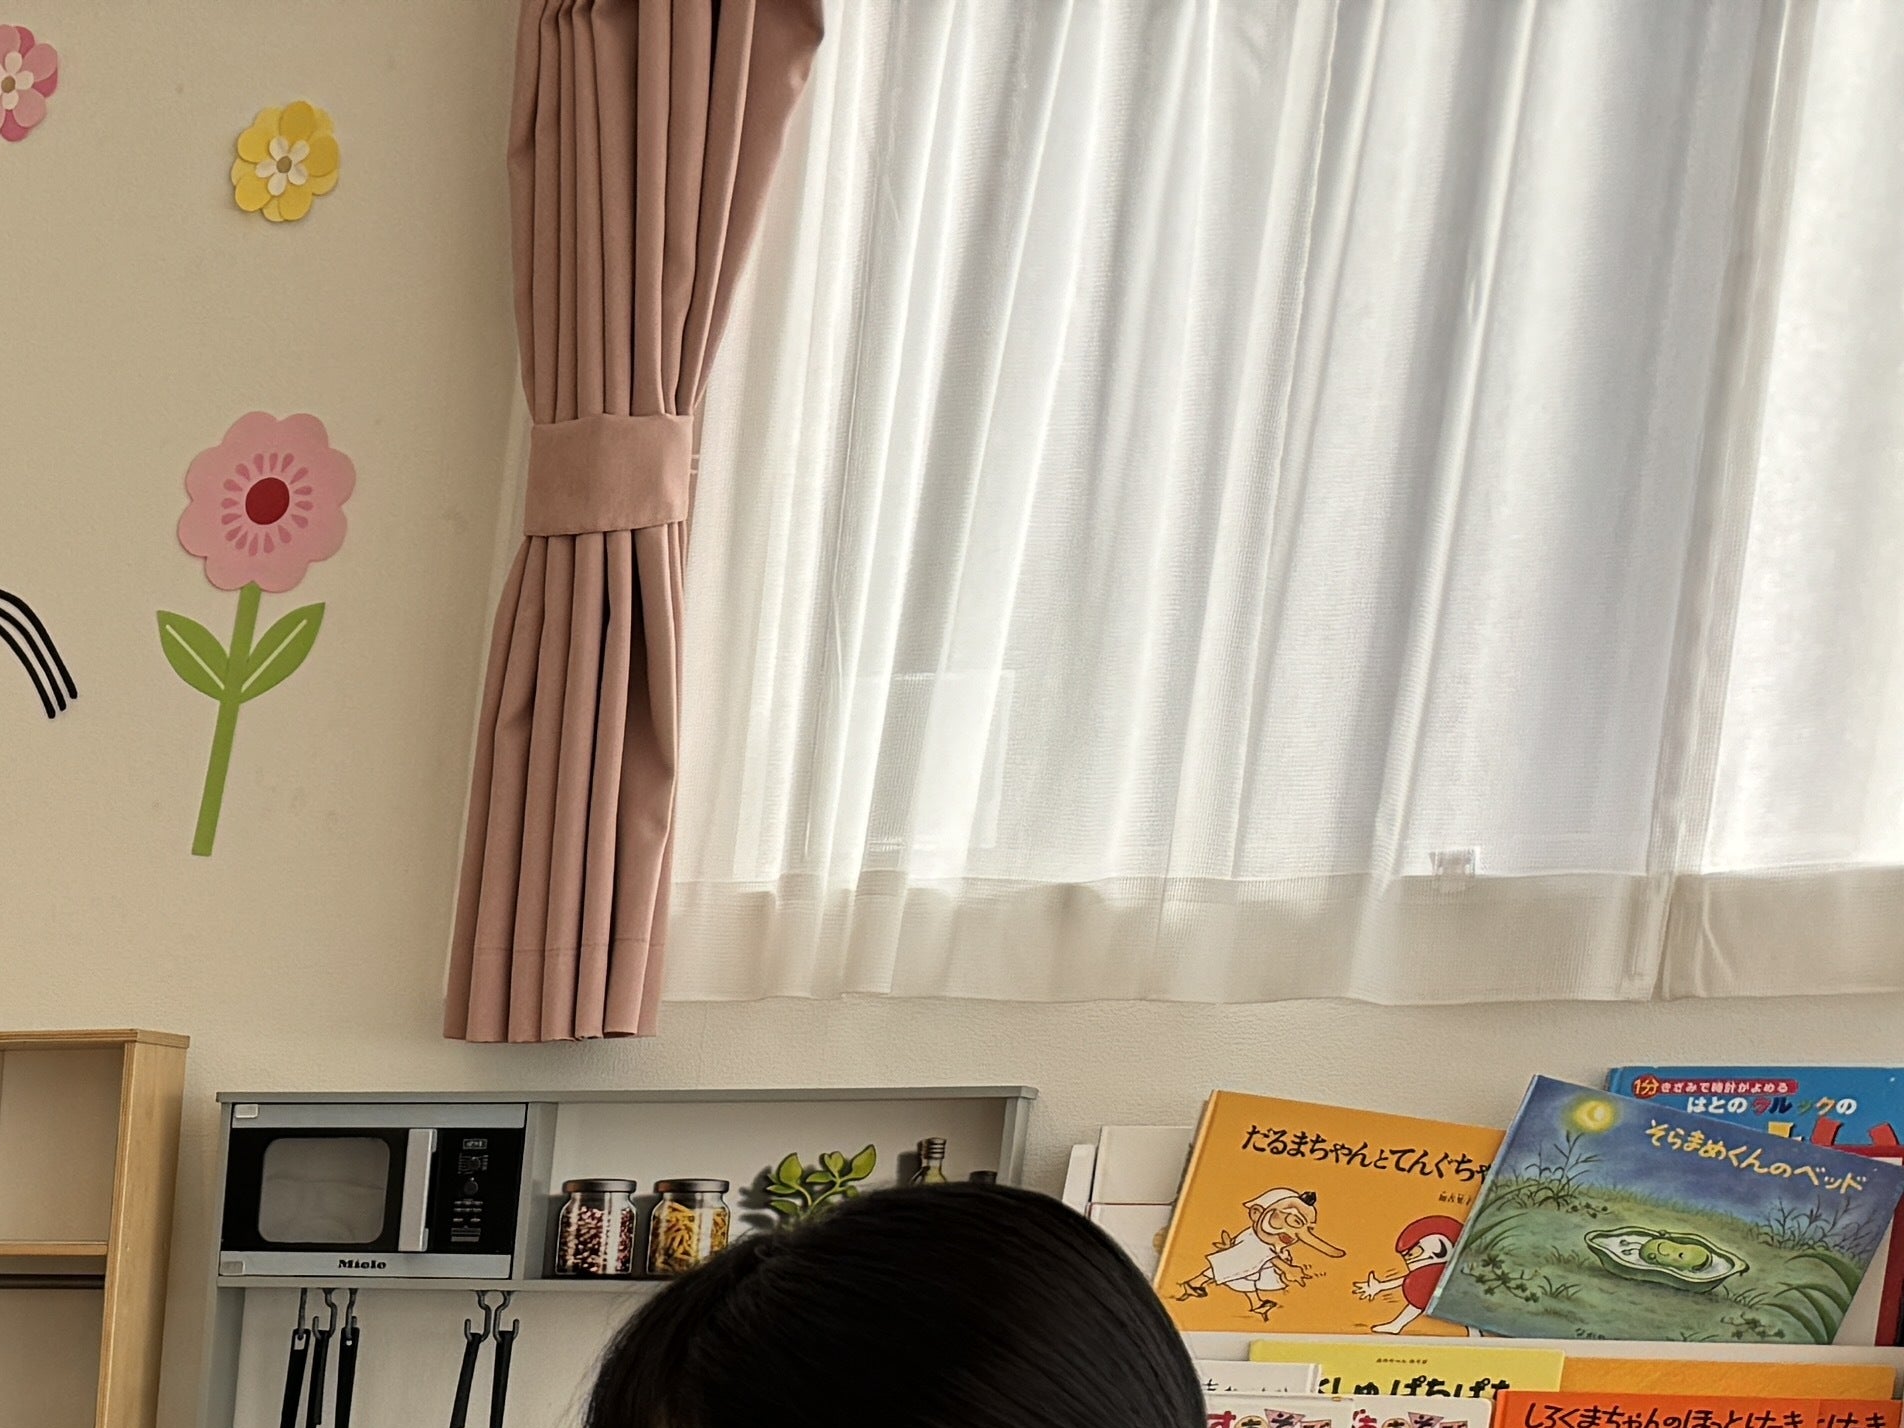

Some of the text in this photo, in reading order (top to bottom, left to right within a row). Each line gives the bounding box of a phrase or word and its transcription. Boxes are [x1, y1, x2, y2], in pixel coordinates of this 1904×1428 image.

[1645, 1119, 1868, 1194] そらまめくんのベッド
